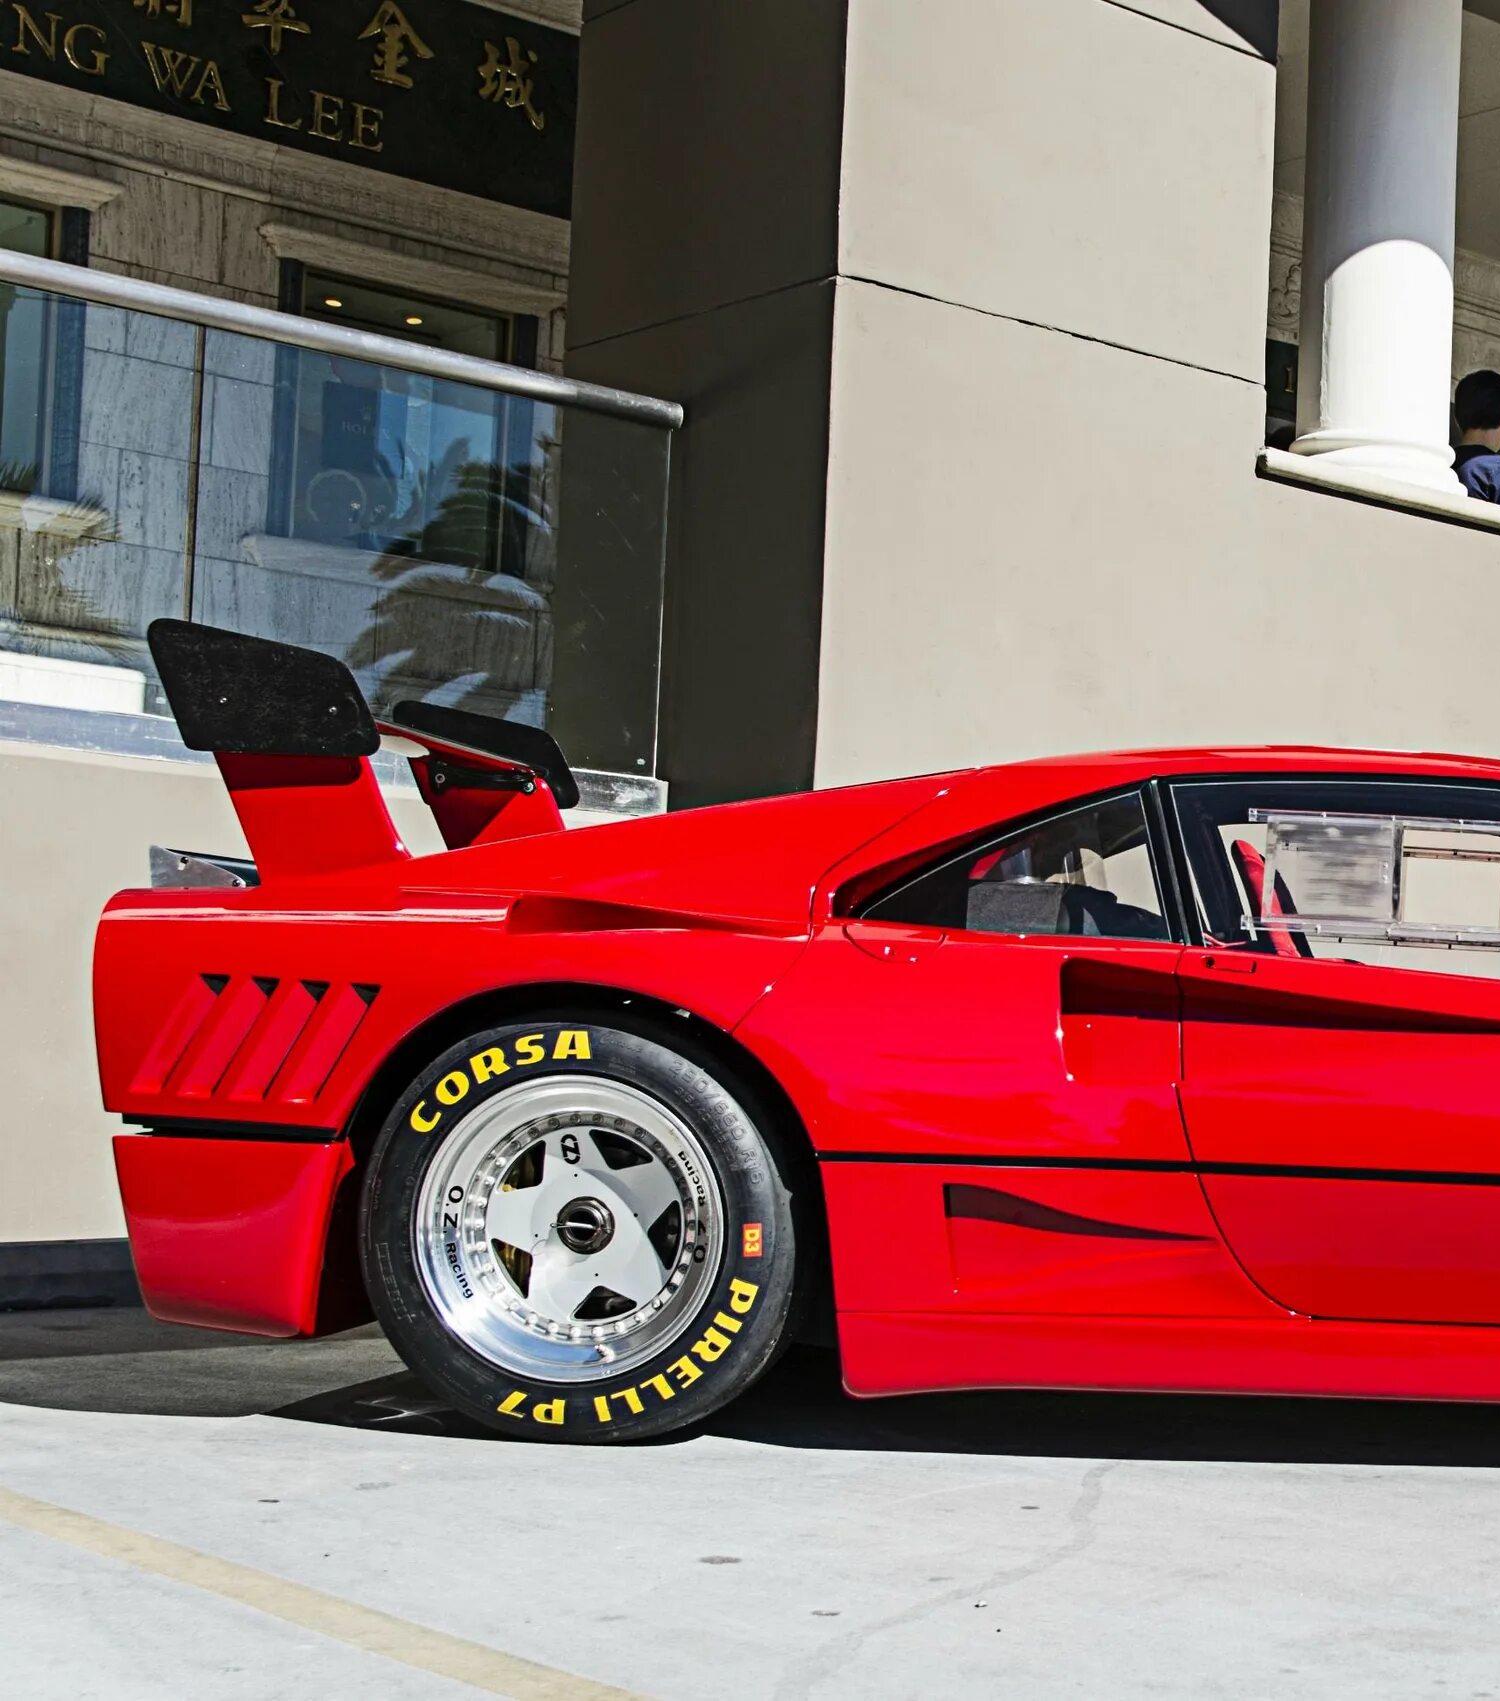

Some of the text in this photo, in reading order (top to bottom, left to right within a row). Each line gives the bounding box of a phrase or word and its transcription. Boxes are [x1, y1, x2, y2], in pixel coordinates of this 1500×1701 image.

[0, 3, 385, 153] NG WA LEE
[410, 1030, 592, 1134] CORSA
[446, 1242, 475, 1299] Racing
[744, 1228, 761, 1253] D3
[497, 1277, 760, 1425] PIRELLI P7
